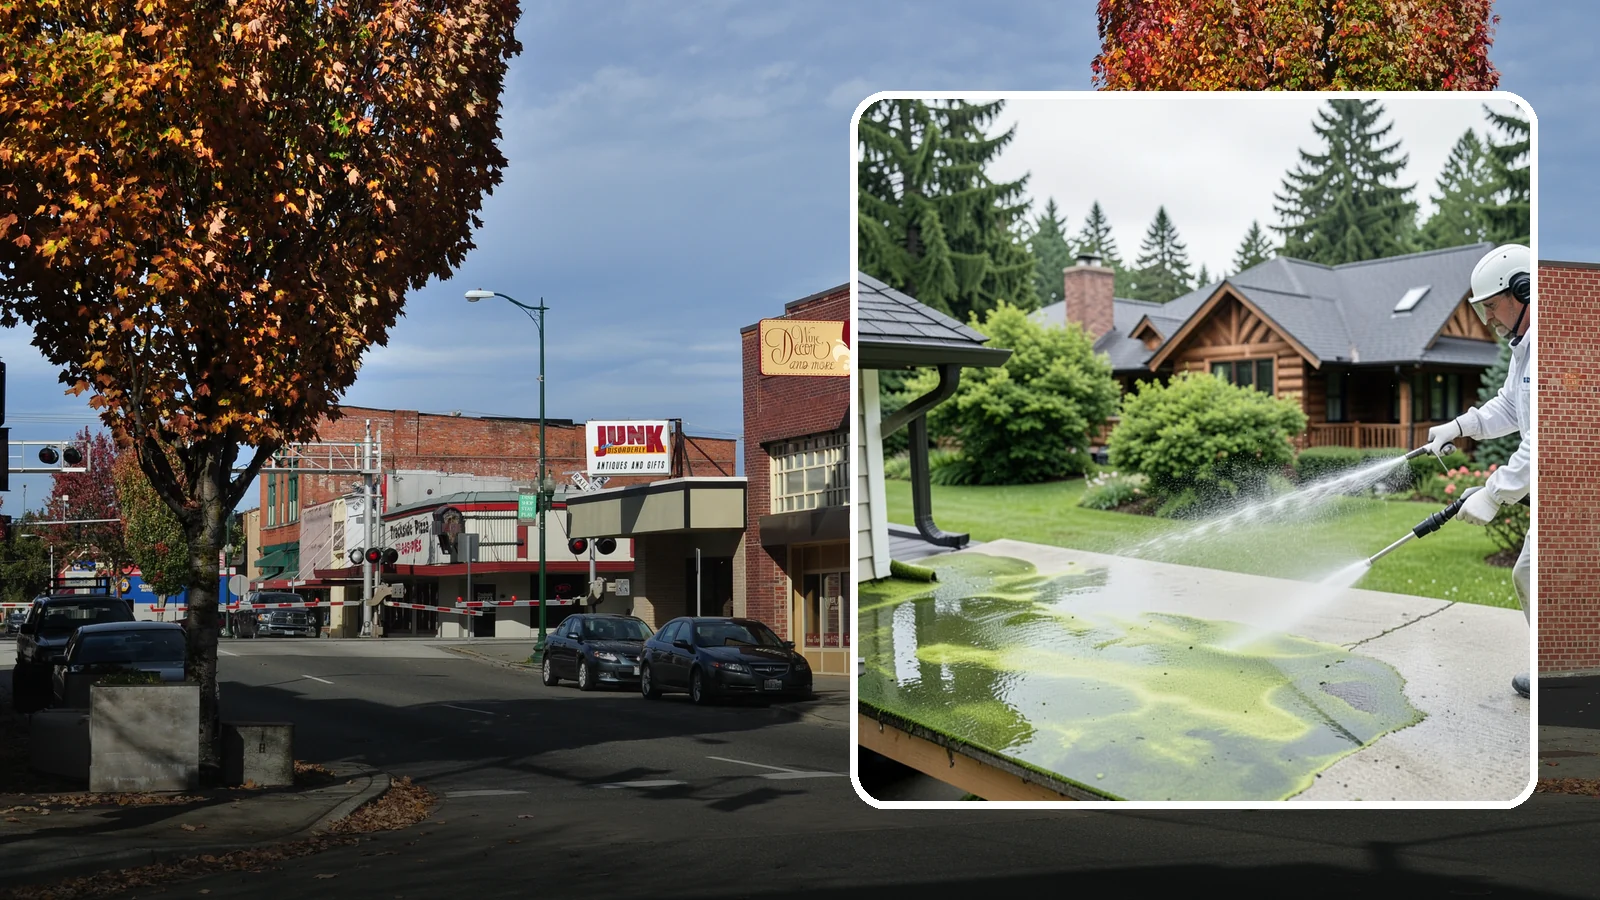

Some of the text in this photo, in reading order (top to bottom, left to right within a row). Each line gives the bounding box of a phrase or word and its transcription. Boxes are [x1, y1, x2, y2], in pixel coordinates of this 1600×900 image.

[595, 425, 664, 457] JUNK
[607, 445, 646, 454] DISORDERLY
[597, 460, 665, 470] ANTIQUES AND GIFTS
[390, 519, 429, 539] Trackside Pizza
